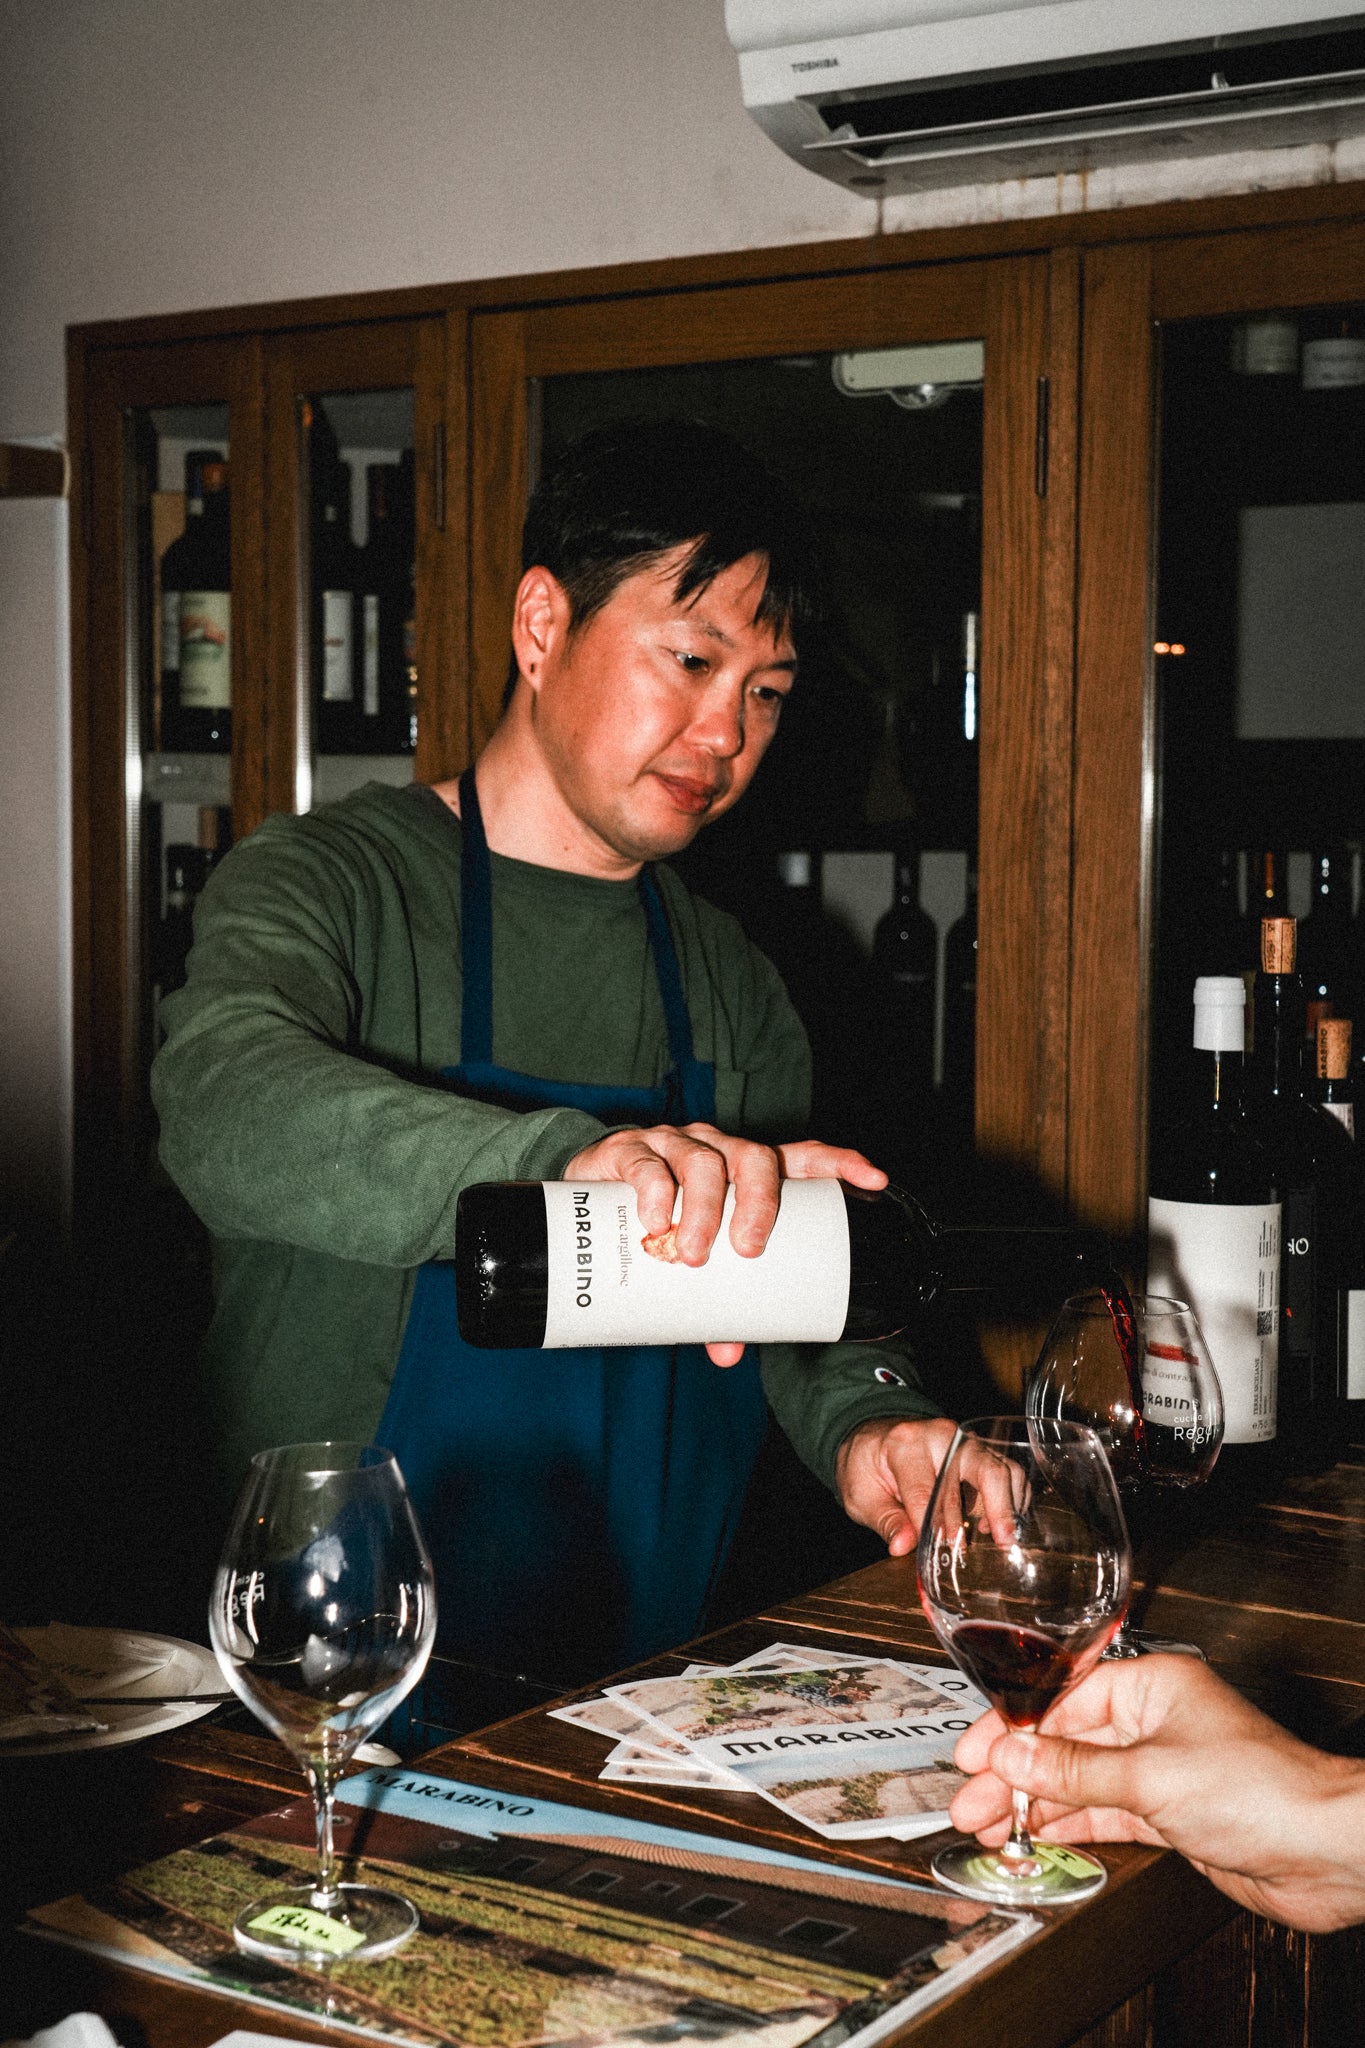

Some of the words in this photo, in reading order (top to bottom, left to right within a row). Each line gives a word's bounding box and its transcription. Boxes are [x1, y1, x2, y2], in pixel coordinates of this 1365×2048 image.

[791, 58, 839, 73] TOSHIBA
[617, 1205, 628, 1231] terre
[573, 1191, 592, 1308] MARABINO
[617, 1233, 633, 1287] argillose
[1174, 1414, 1203, 1424] cucia
[721, 1719, 974, 1757] MARABINO
[367, 1773, 535, 1817] MARABINO
